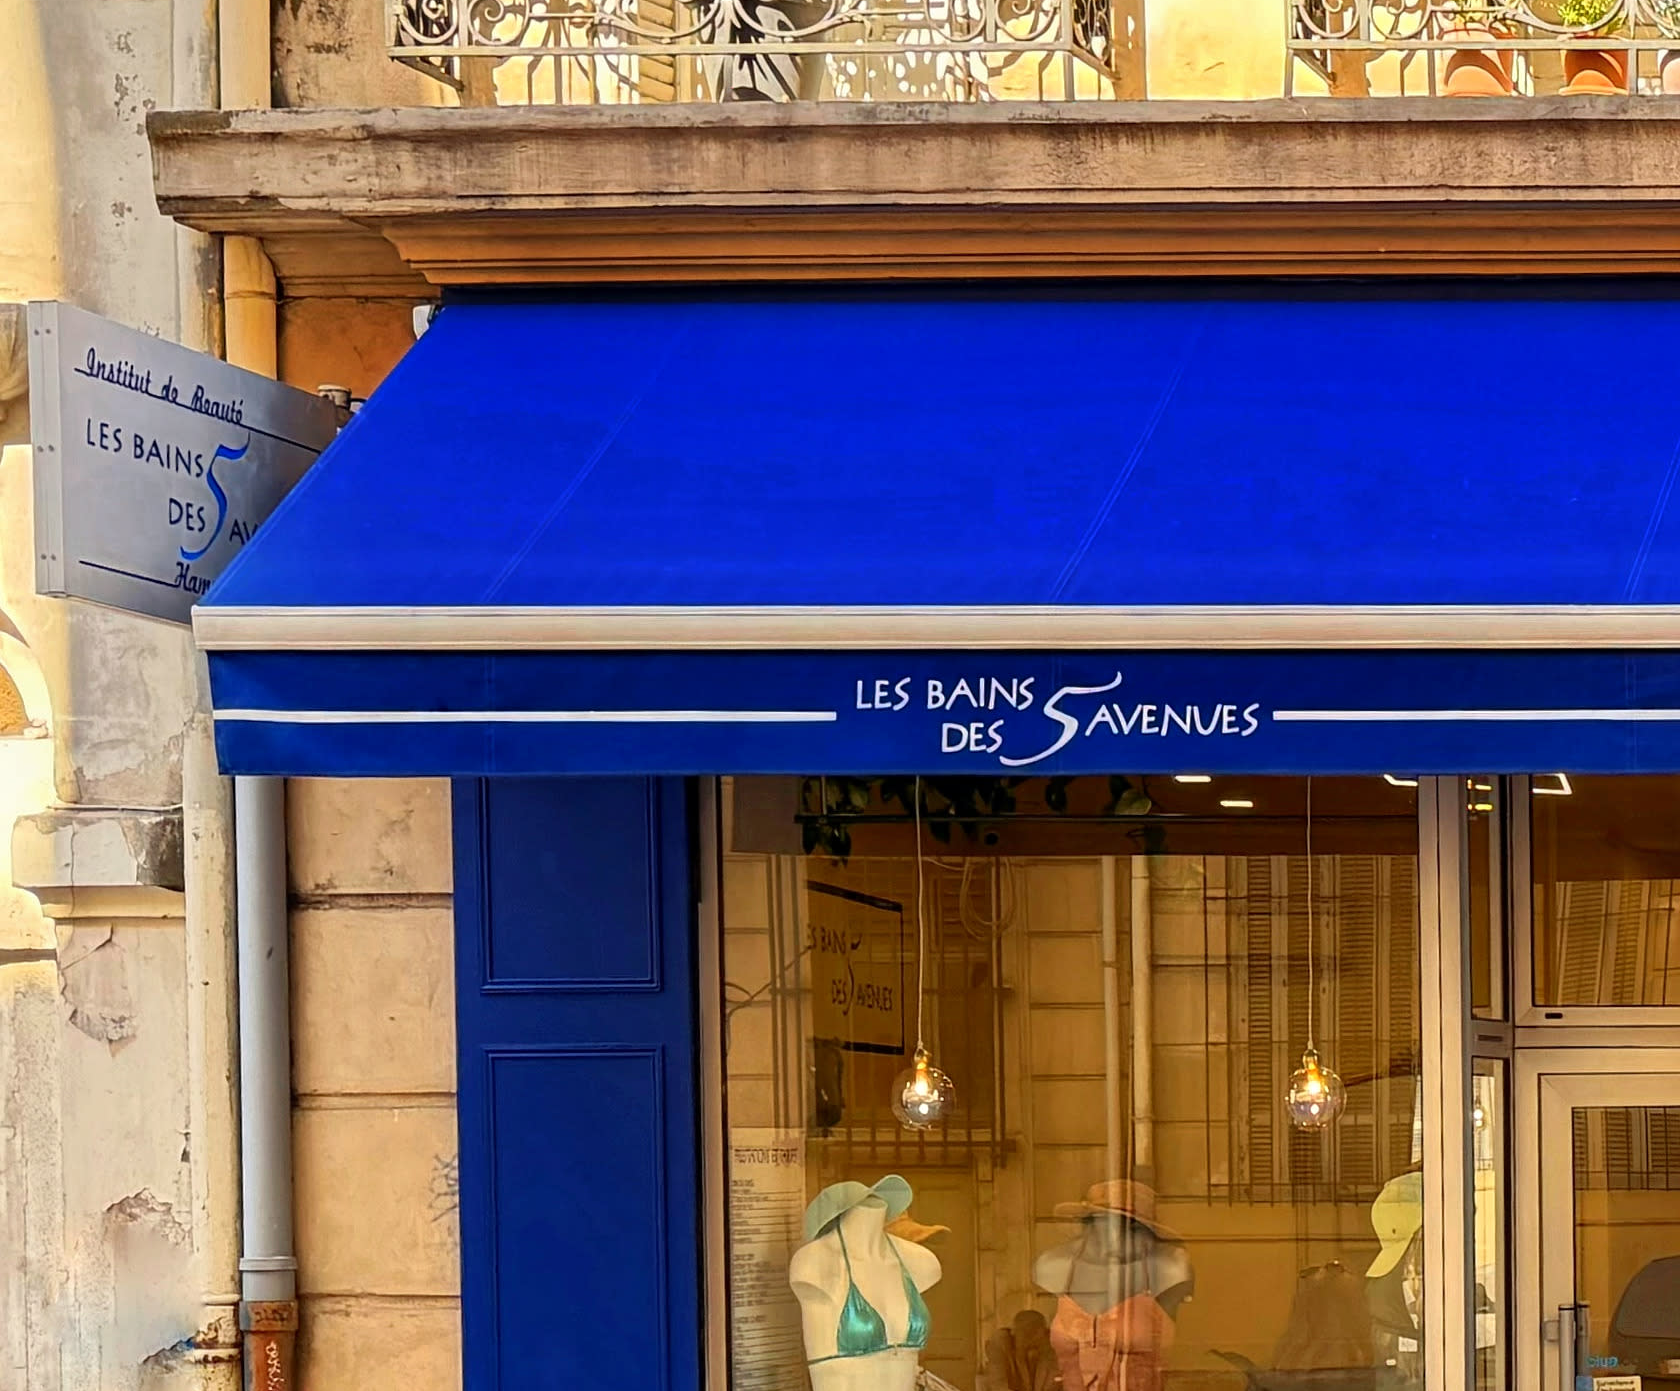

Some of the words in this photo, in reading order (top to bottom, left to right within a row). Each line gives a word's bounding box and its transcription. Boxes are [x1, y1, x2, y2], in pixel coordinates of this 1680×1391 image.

[86, 347, 152, 395] Institut
[161, 375, 179, 403] de
[190, 385, 244, 425] Beauté
[86, 418, 122, 452] LES
[133, 433, 204, 478] BAINS
[168, 497, 206, 532] DES
[180, 432, 250, 560] 5
[856, 677, 911, 710] LES
[927, 677, 1035, 711] BAINS
[942, 720, 1004, 753] DES
[999, 672, 1123, 766] 5
[1085, 703, 1260, 737] AVENUES
